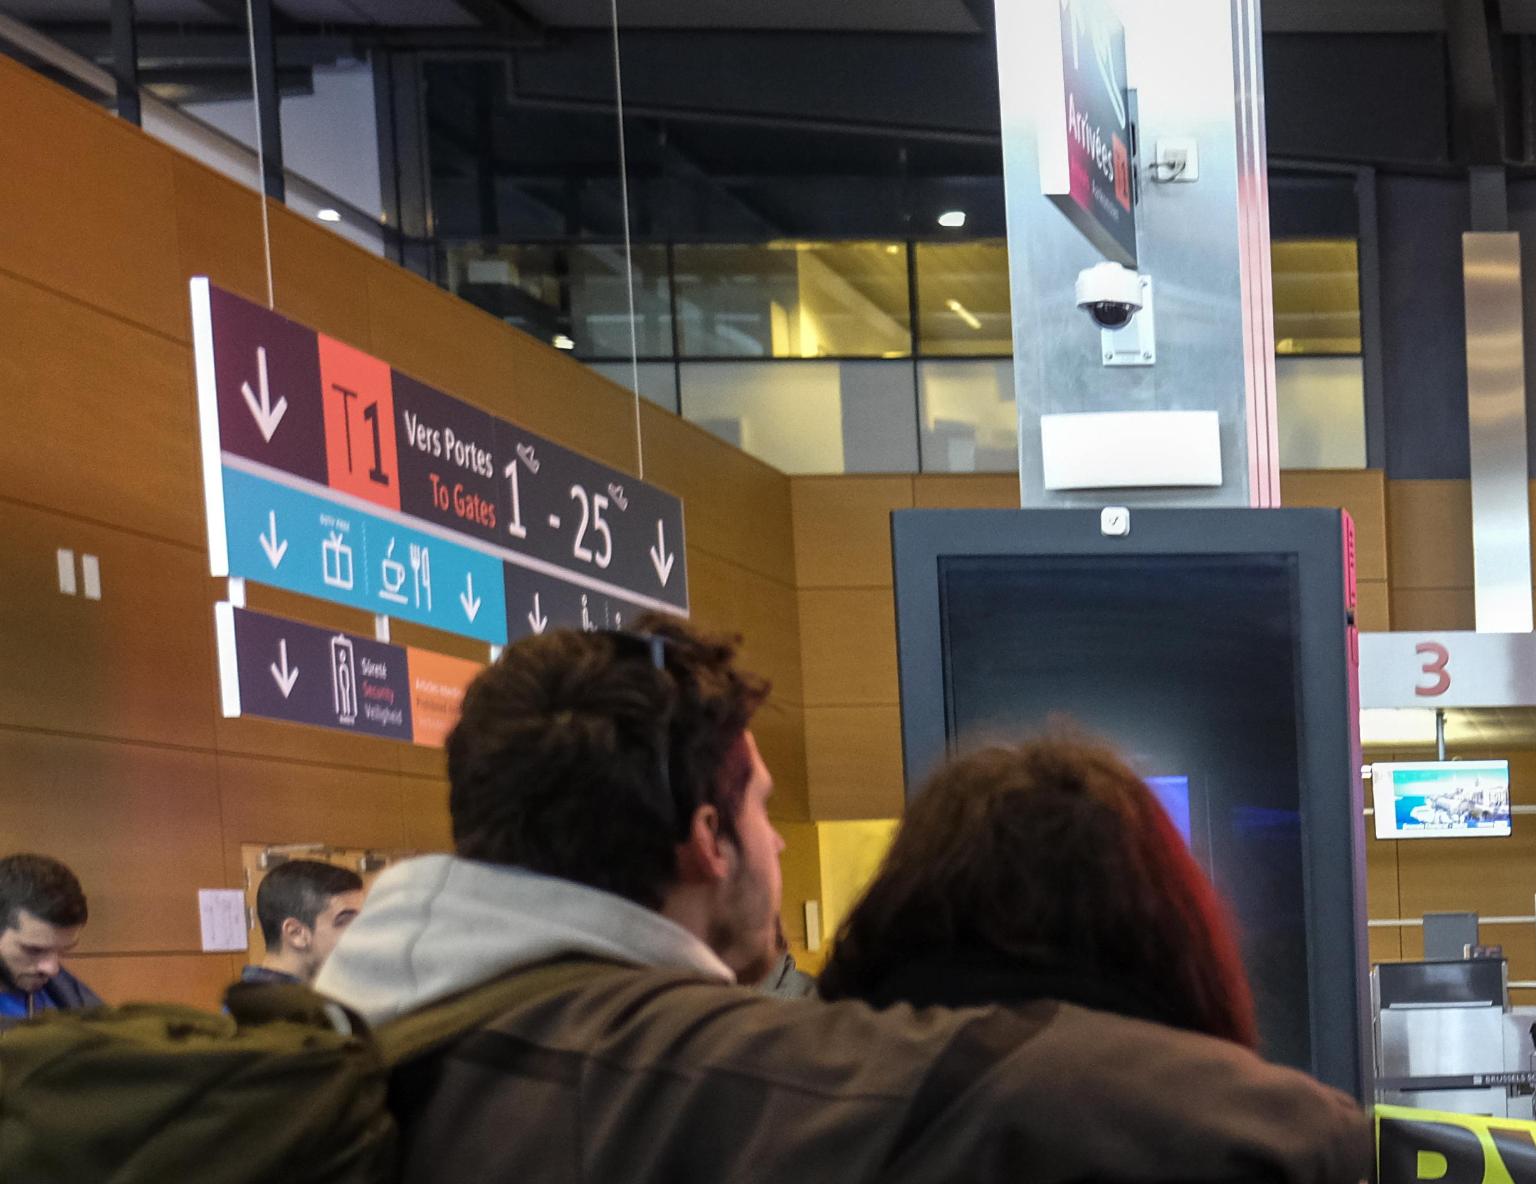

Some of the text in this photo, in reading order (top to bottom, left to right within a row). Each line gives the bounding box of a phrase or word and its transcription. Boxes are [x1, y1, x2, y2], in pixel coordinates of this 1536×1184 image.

[332, 383, 390, 487] T1
[404, 409, 494, 479] Vers Portes
[430, 473, 497, 530] To Gates
[506, 460, 528, 540] 1
[570, 483, 613, 570] 25
[1415, 642, 1452, 697] 3
[1485, 1074, 1526, 1085] BRUSSELS
